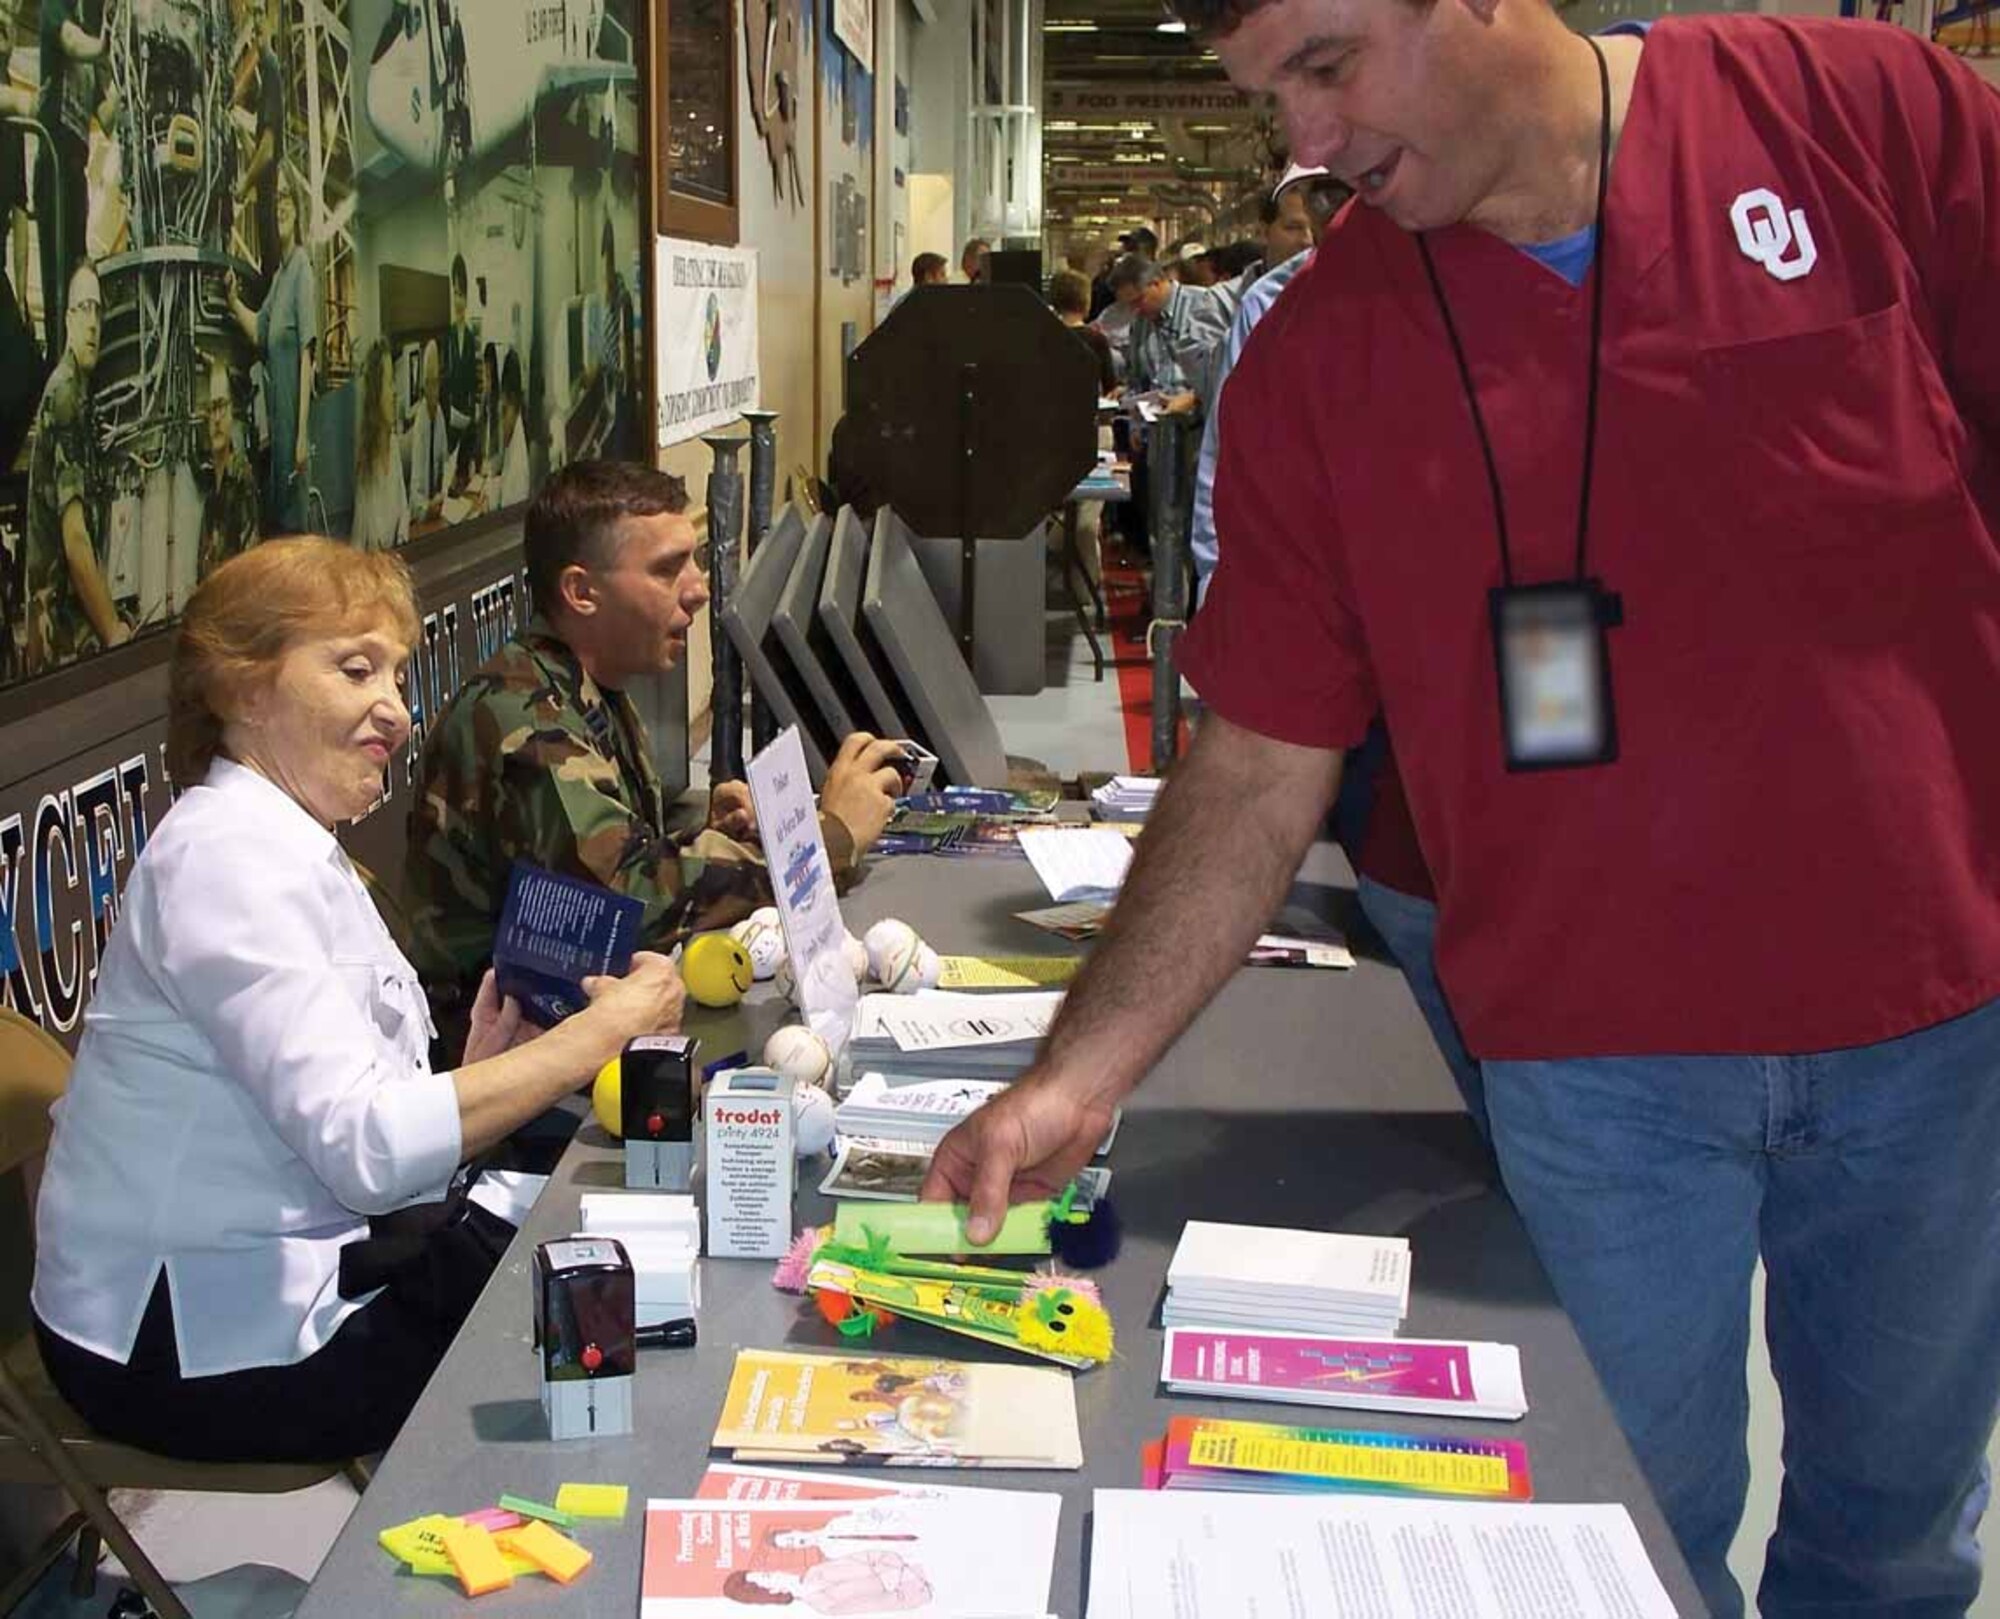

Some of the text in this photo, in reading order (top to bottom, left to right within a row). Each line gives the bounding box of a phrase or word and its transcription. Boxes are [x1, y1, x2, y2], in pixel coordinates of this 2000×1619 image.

[1077, 93, 1250, 109] FOD PREVENTION
[1729, 187, 1818, 282] OU
[714, 1107, 782, 1124] trodat
[717, 1126, 780, 1141] printy 4924
